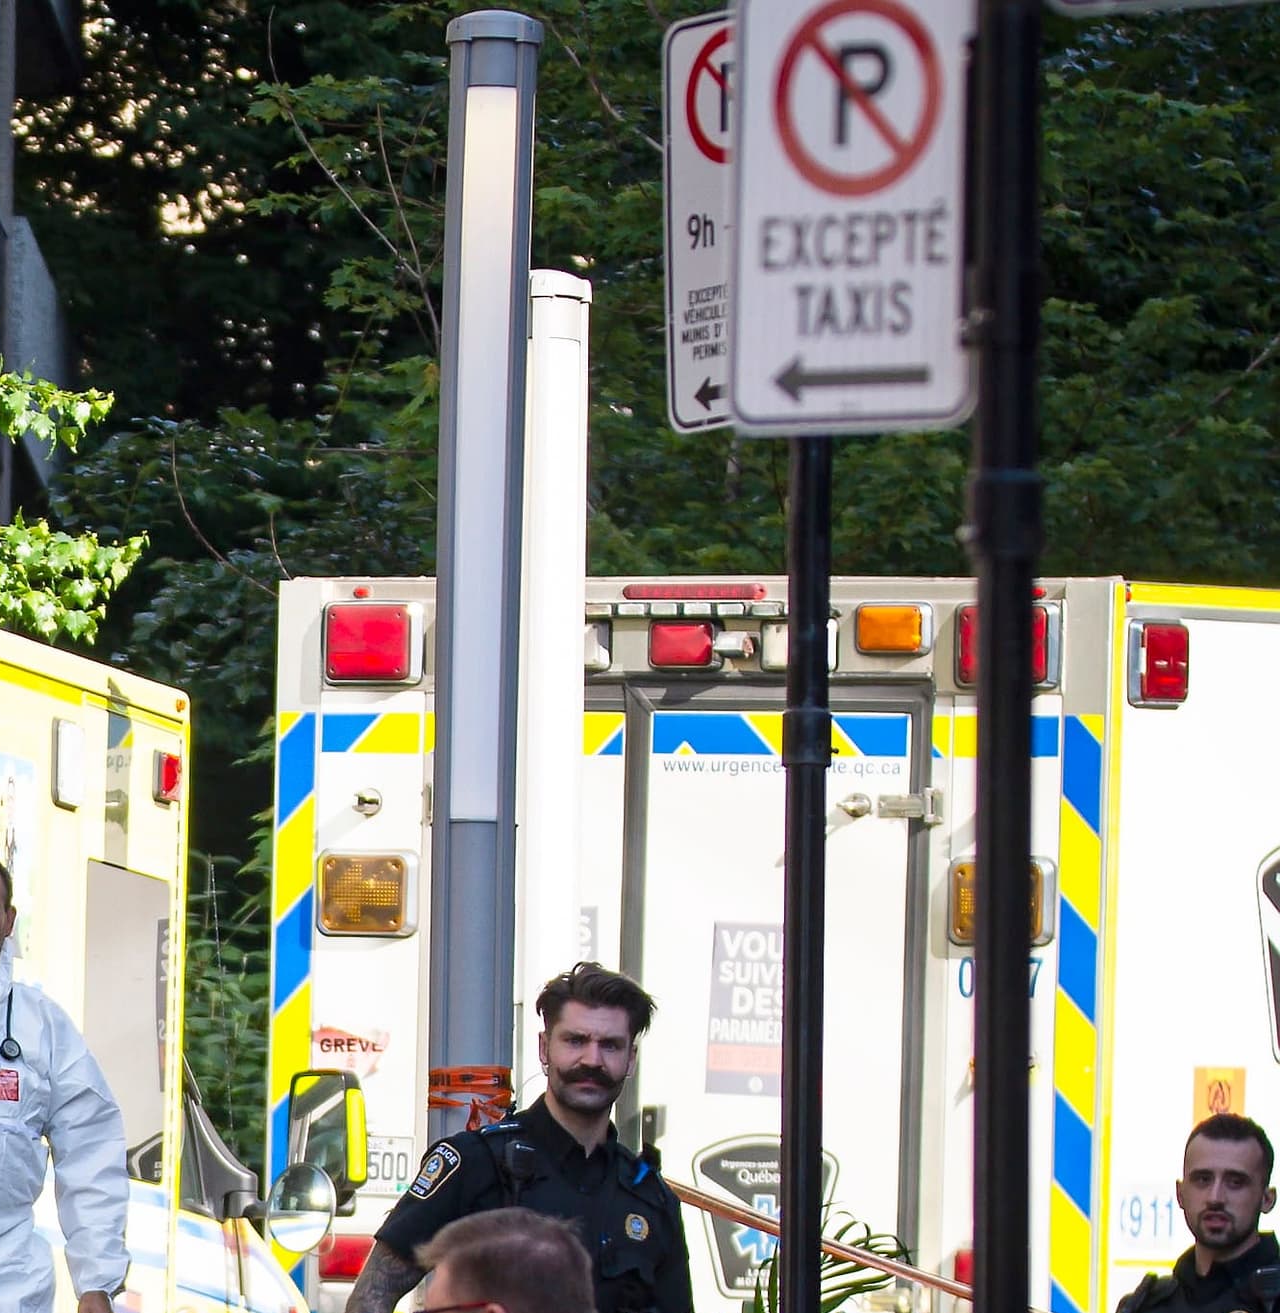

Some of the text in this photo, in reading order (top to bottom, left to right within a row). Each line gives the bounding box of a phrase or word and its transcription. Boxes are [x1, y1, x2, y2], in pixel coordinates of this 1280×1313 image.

[687, 213, 715, 249] 9h
[760, 199, 947, 270] EXCEPTÉ
[794, 280, 913, 338] TAXIS
[721, 930, 783, 960] VOU
[718, 960, 783, 985] SUIV
[958, 956, 1044, 998] 07
[367, 1151, 409, 1181] 500
[738, 1167, 781, 1185] Québe
